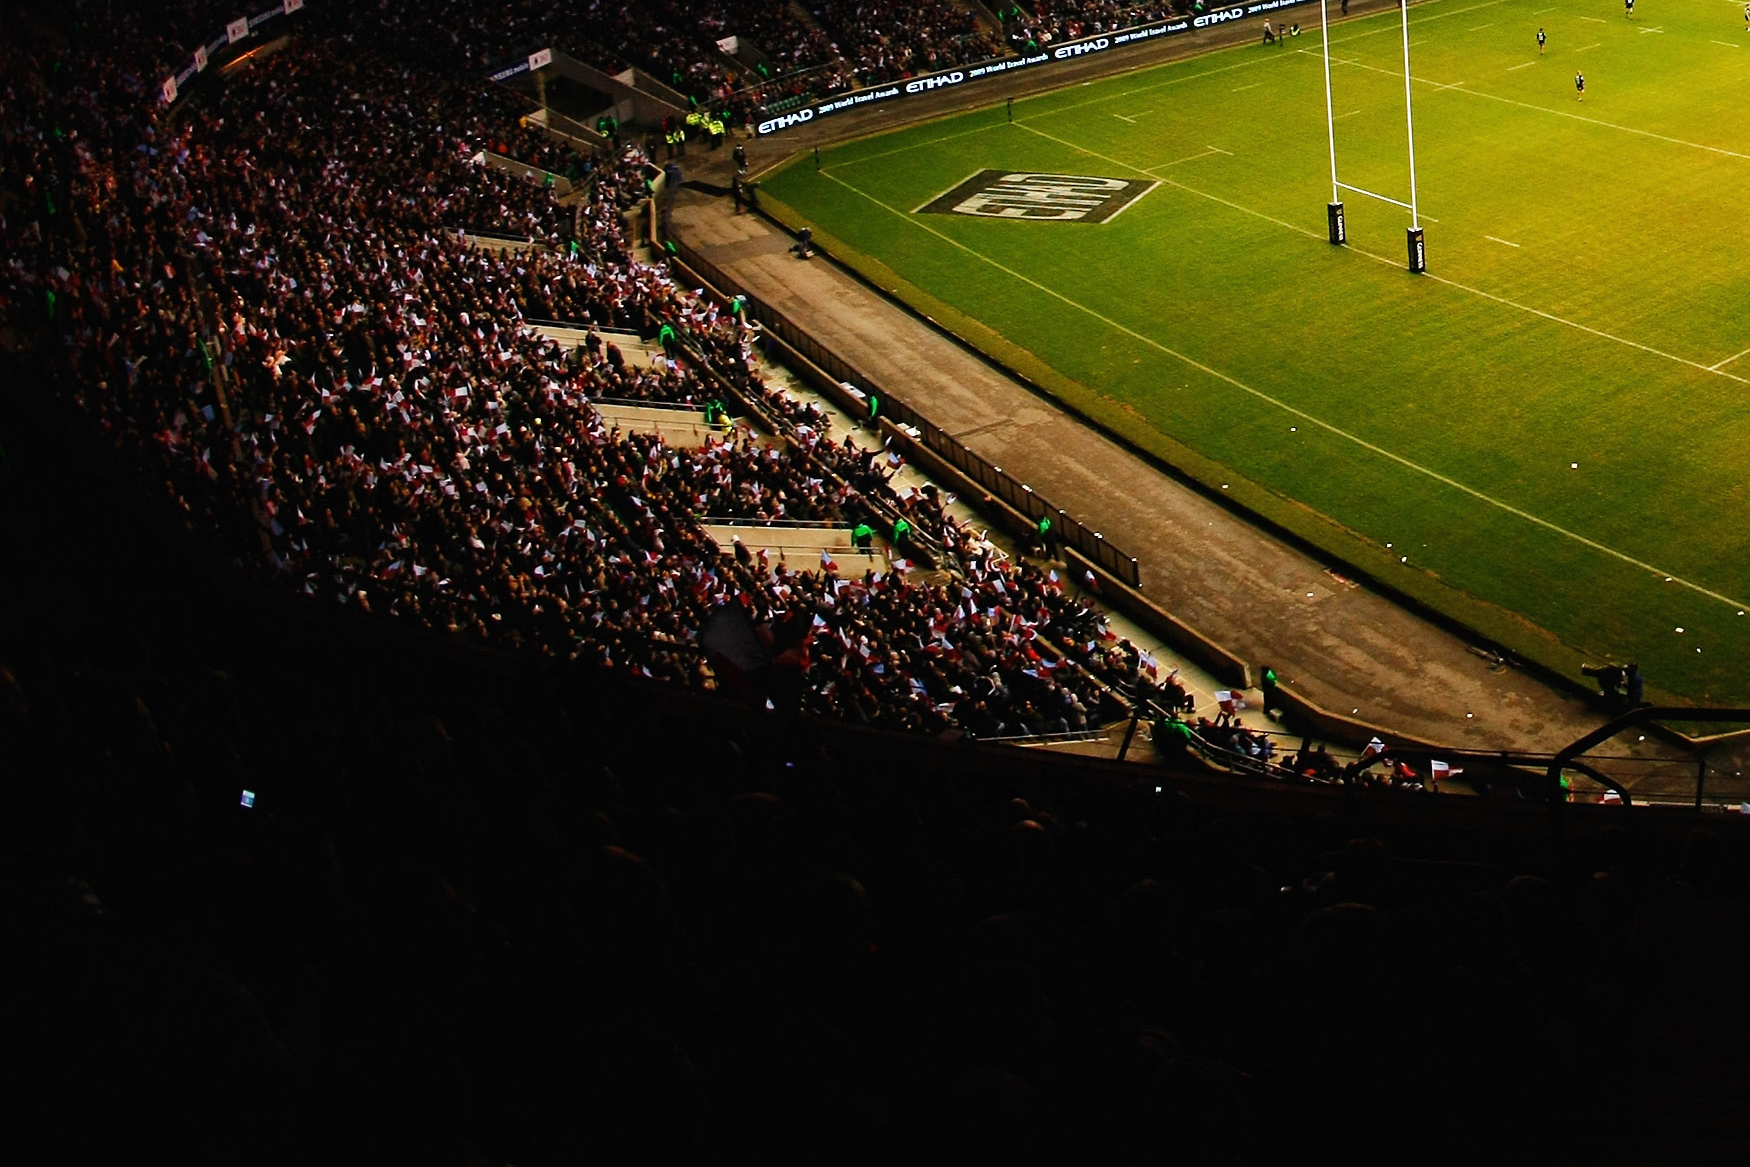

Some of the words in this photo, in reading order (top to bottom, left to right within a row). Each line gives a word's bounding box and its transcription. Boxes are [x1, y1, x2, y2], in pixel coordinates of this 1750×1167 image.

[1194, 8, 1243, 27] ETIHAD
[1248, 5, 1261, 13] 2009
[1262, 1, 1278, 10] World
[1055, 39, 1109, 58] ETIHAD
[1114, 34, 1129, 44] 2009
[1131, 30, 1148, 40] World
[1149, 26, 1166, 35] Travel
[906, 72, 964, 93] ETIHAD
[969, 68, 985, 77] 2009
[987, 62, 1006, 72] World
[1007, 58, 1025, 68] Travel
[1027, 53, 1048, 63] Awards
[758, 109, 813, 134] ETIHAD
[819, 105, 833, 114] 2009
[835, 98, 853, 110] World
[854, 92, 874, 103] Travel
[875, 88, 899, 98] Awards
